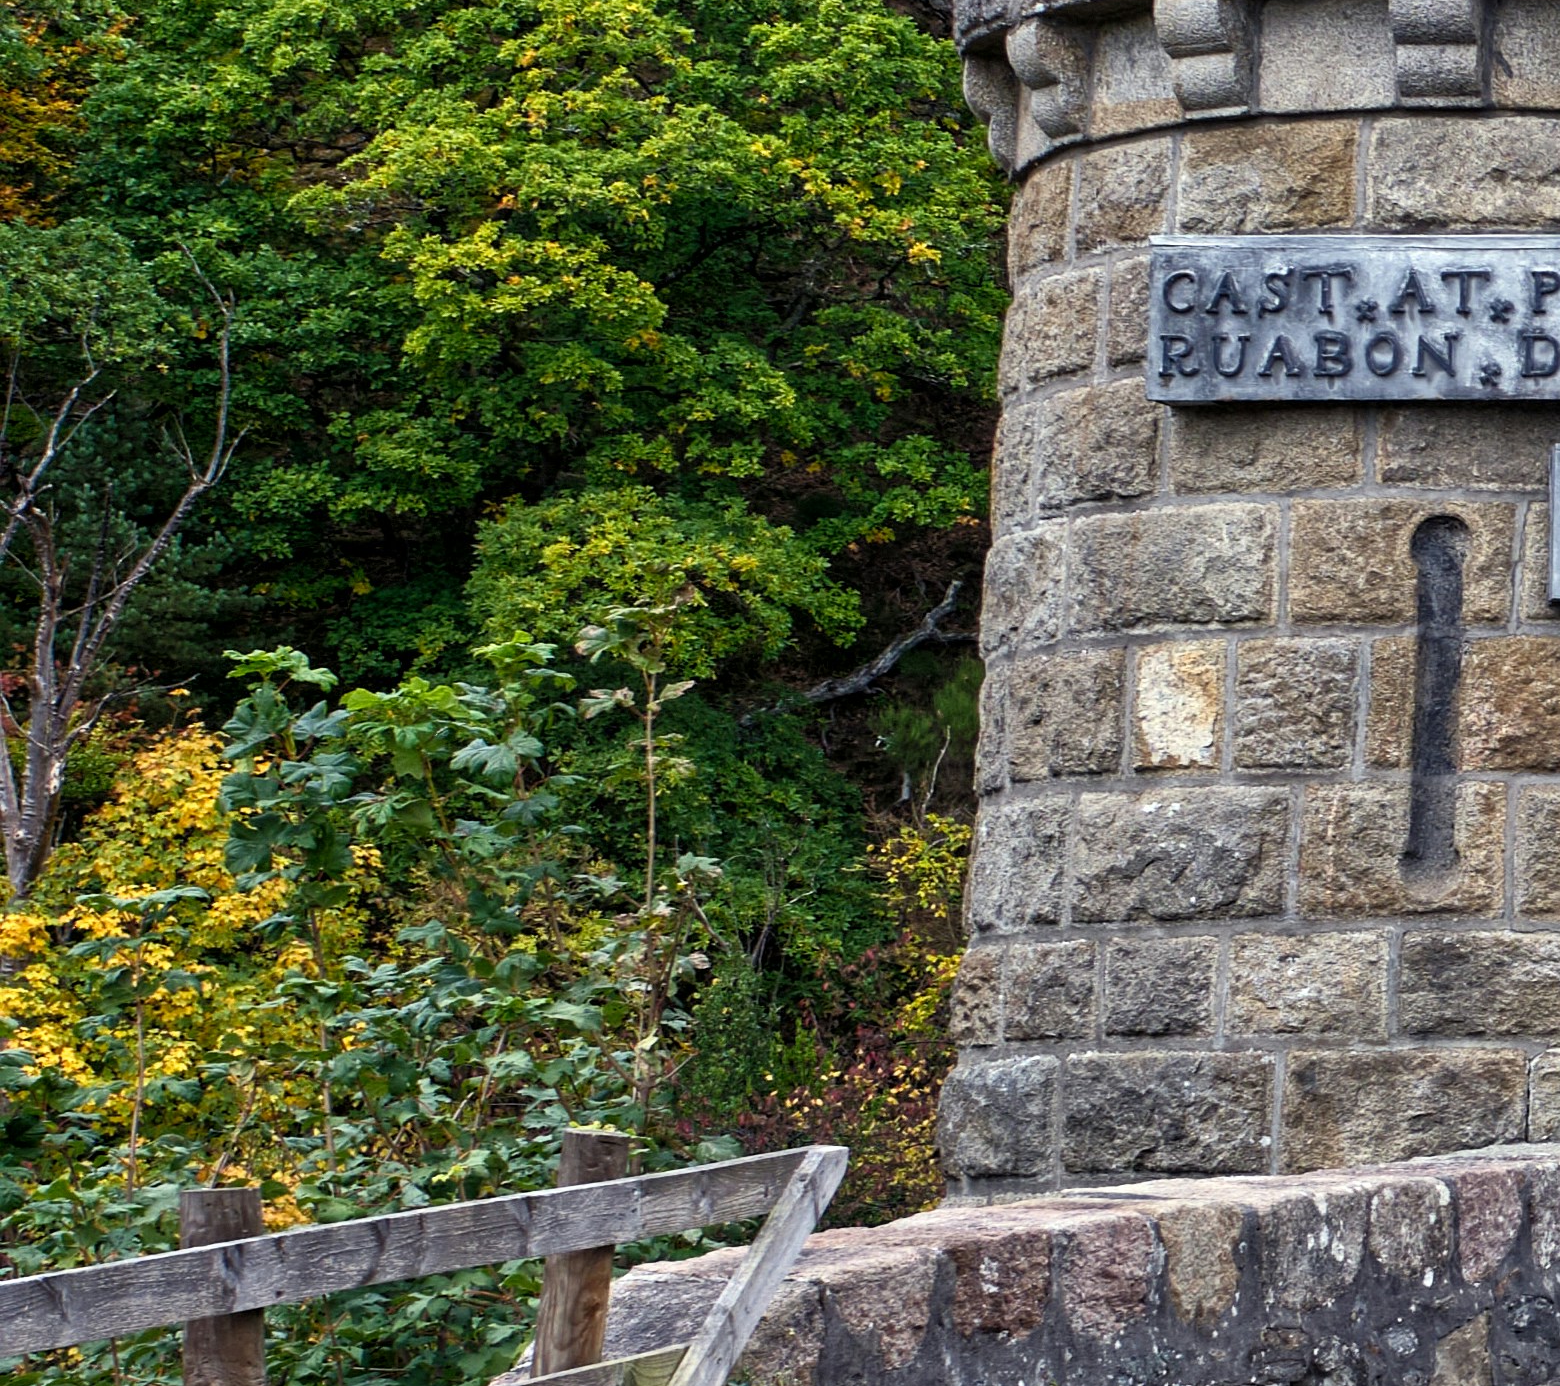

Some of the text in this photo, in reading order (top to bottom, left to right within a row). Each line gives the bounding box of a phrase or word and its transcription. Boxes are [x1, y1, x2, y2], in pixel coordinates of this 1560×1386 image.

[1162, 265, 1351, 316] CAST
[1388, 268, 1492, 315] AT
[1158, 329, 1461, 377] RUABON
